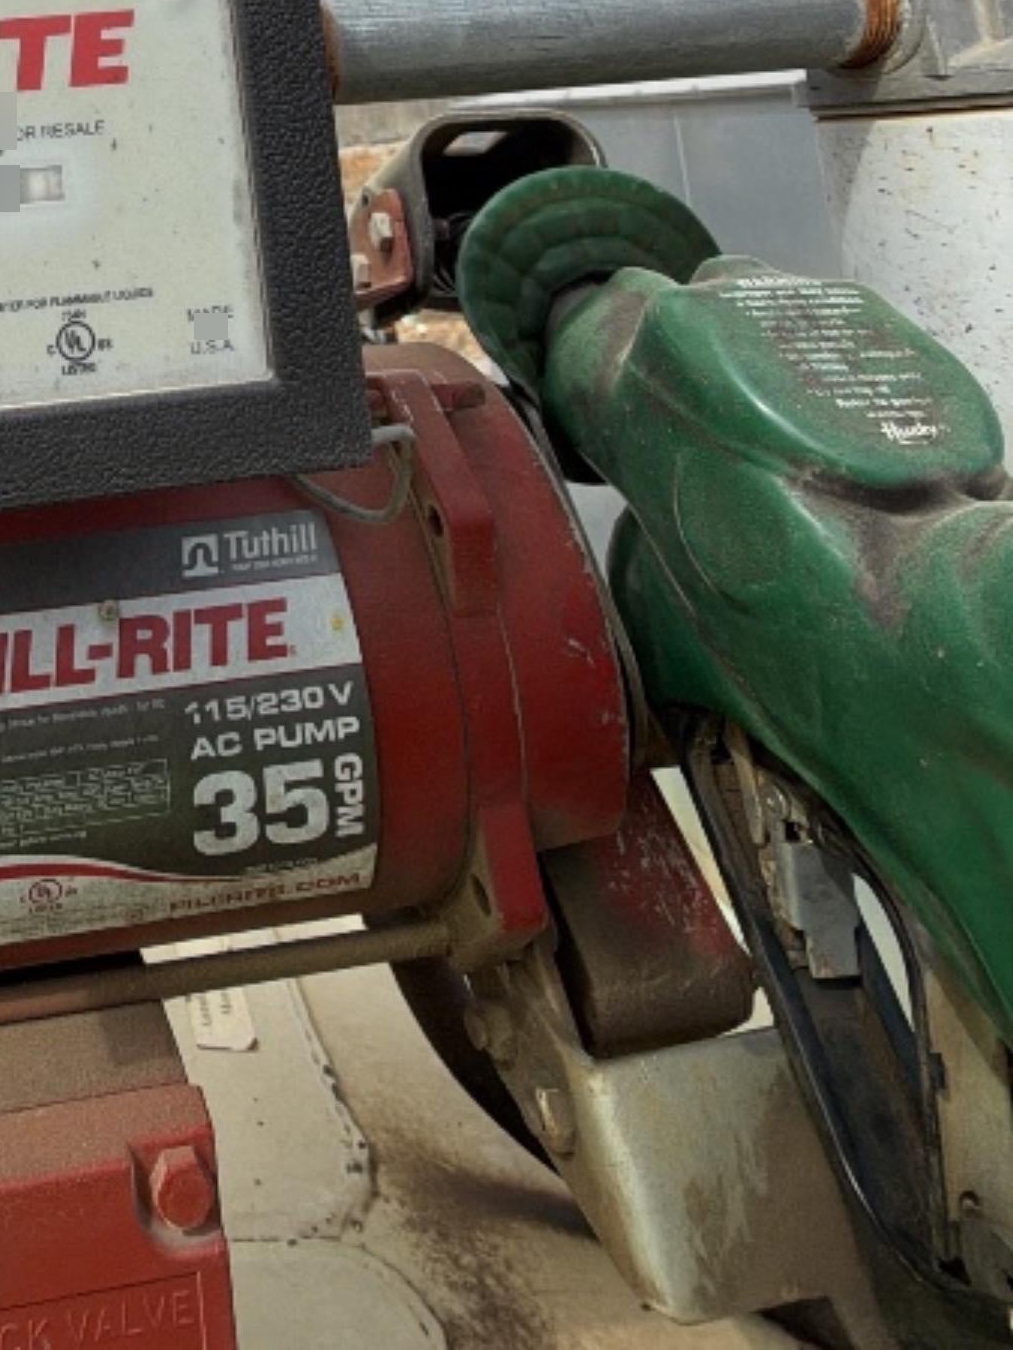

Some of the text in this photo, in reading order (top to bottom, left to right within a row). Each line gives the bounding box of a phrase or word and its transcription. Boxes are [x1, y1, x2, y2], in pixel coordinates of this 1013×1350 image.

[224, 522, 318, 561] Tuthill
[184, 681, 354, 725] 115/230 V
[190, 715, 360, 761] AC PUMP
[193, 758, 331, 856] 35
[334, 752, 364, 837] GPM
